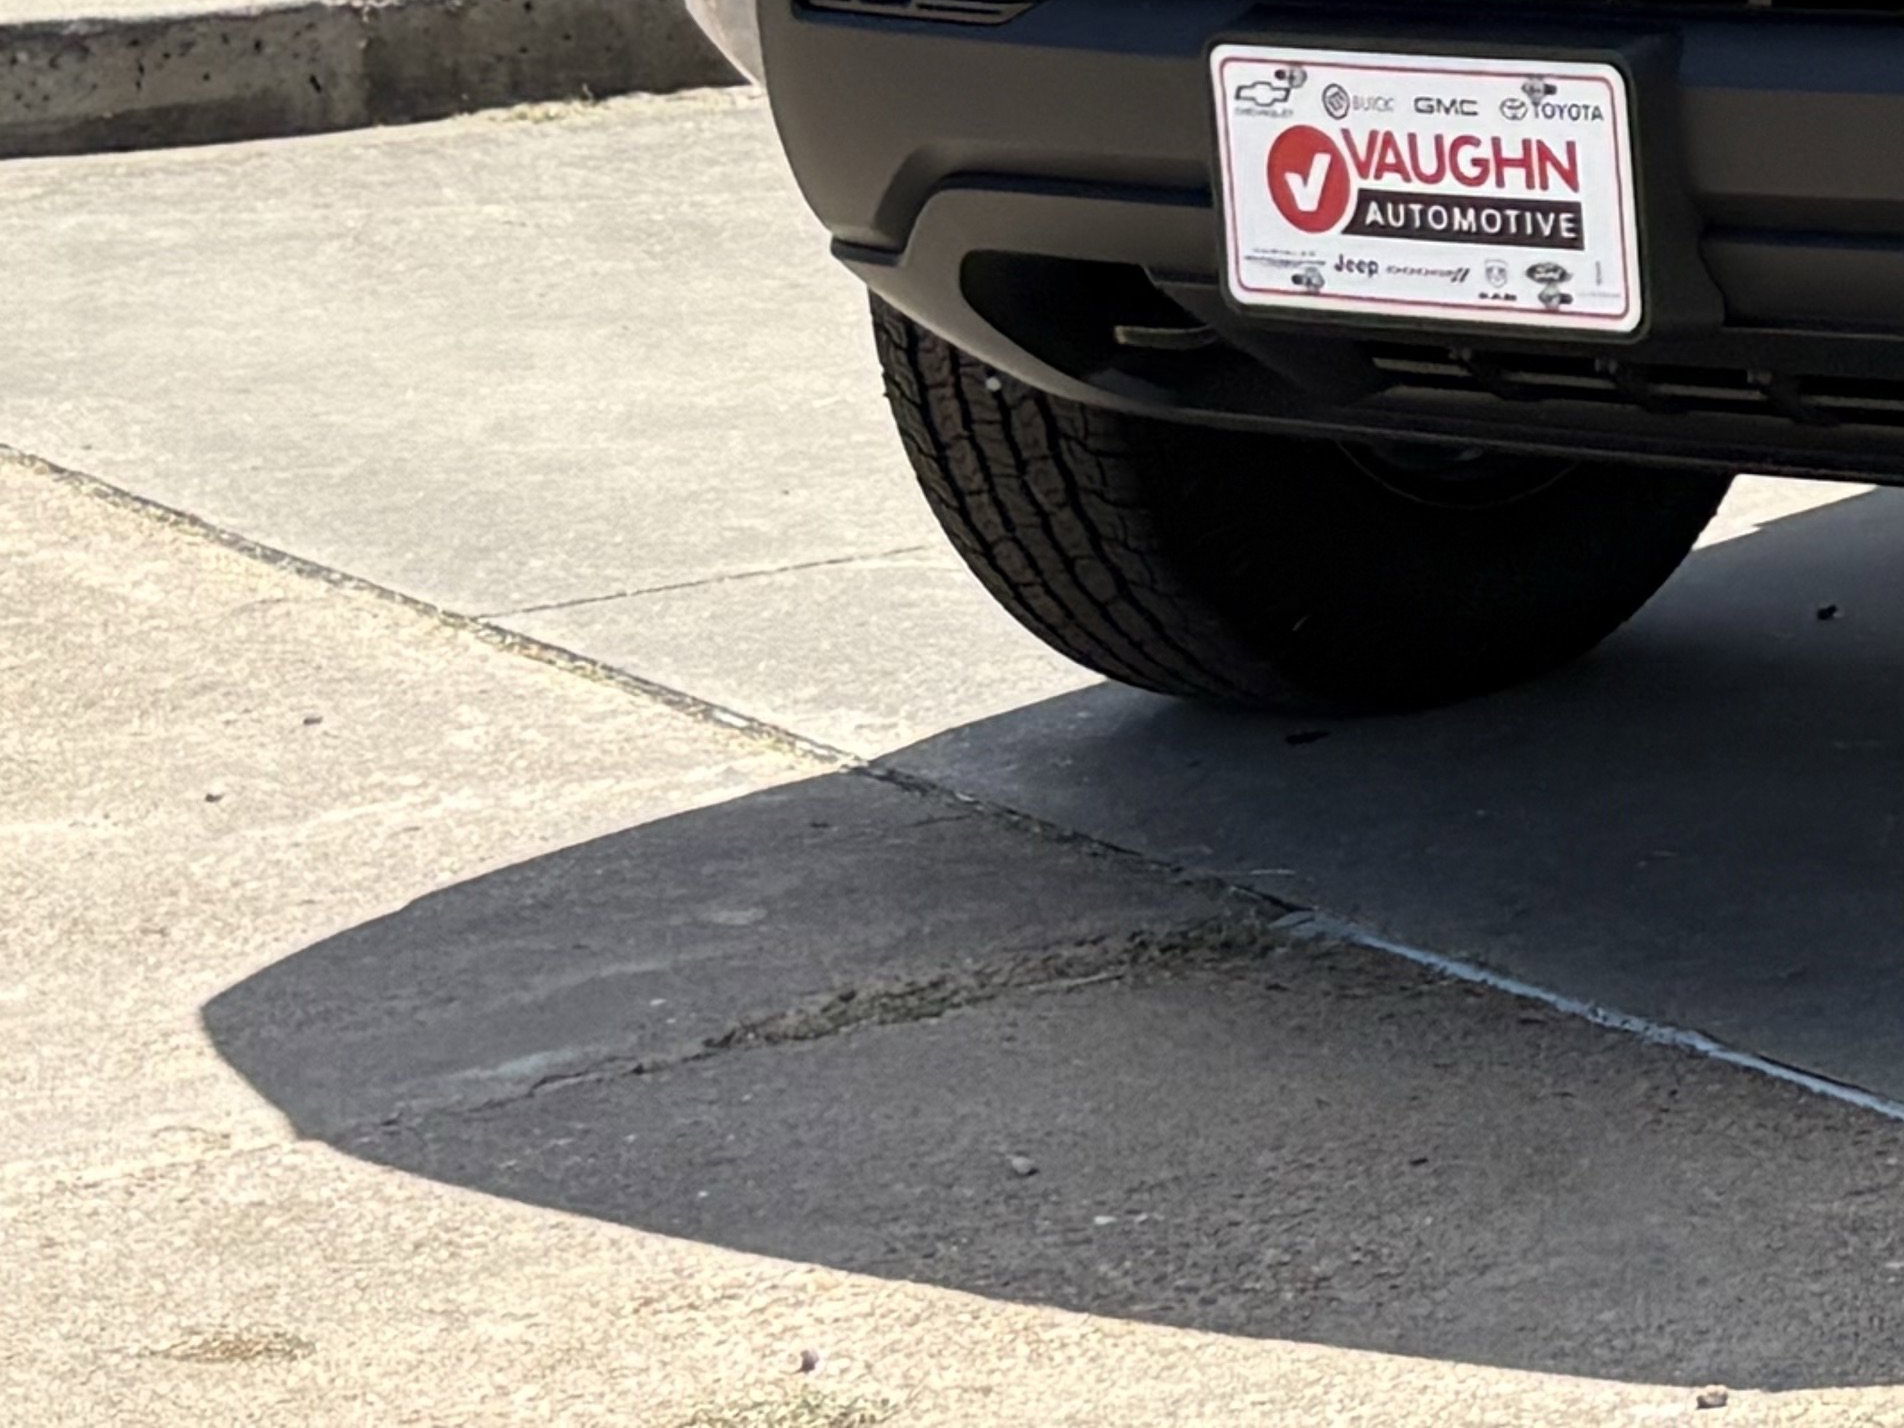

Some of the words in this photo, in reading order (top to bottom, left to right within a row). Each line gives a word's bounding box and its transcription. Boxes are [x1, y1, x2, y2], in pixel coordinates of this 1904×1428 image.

[1413, 96, 1479, 116] GMC
[1531, 101, 1604, 122] TOYOTA
[1341, 127, 1581, 193] VAUGHN
[1364, 199, 1579, 239] AUTOMOTIVE
[1333, 254, 1379, 278] Jeep
